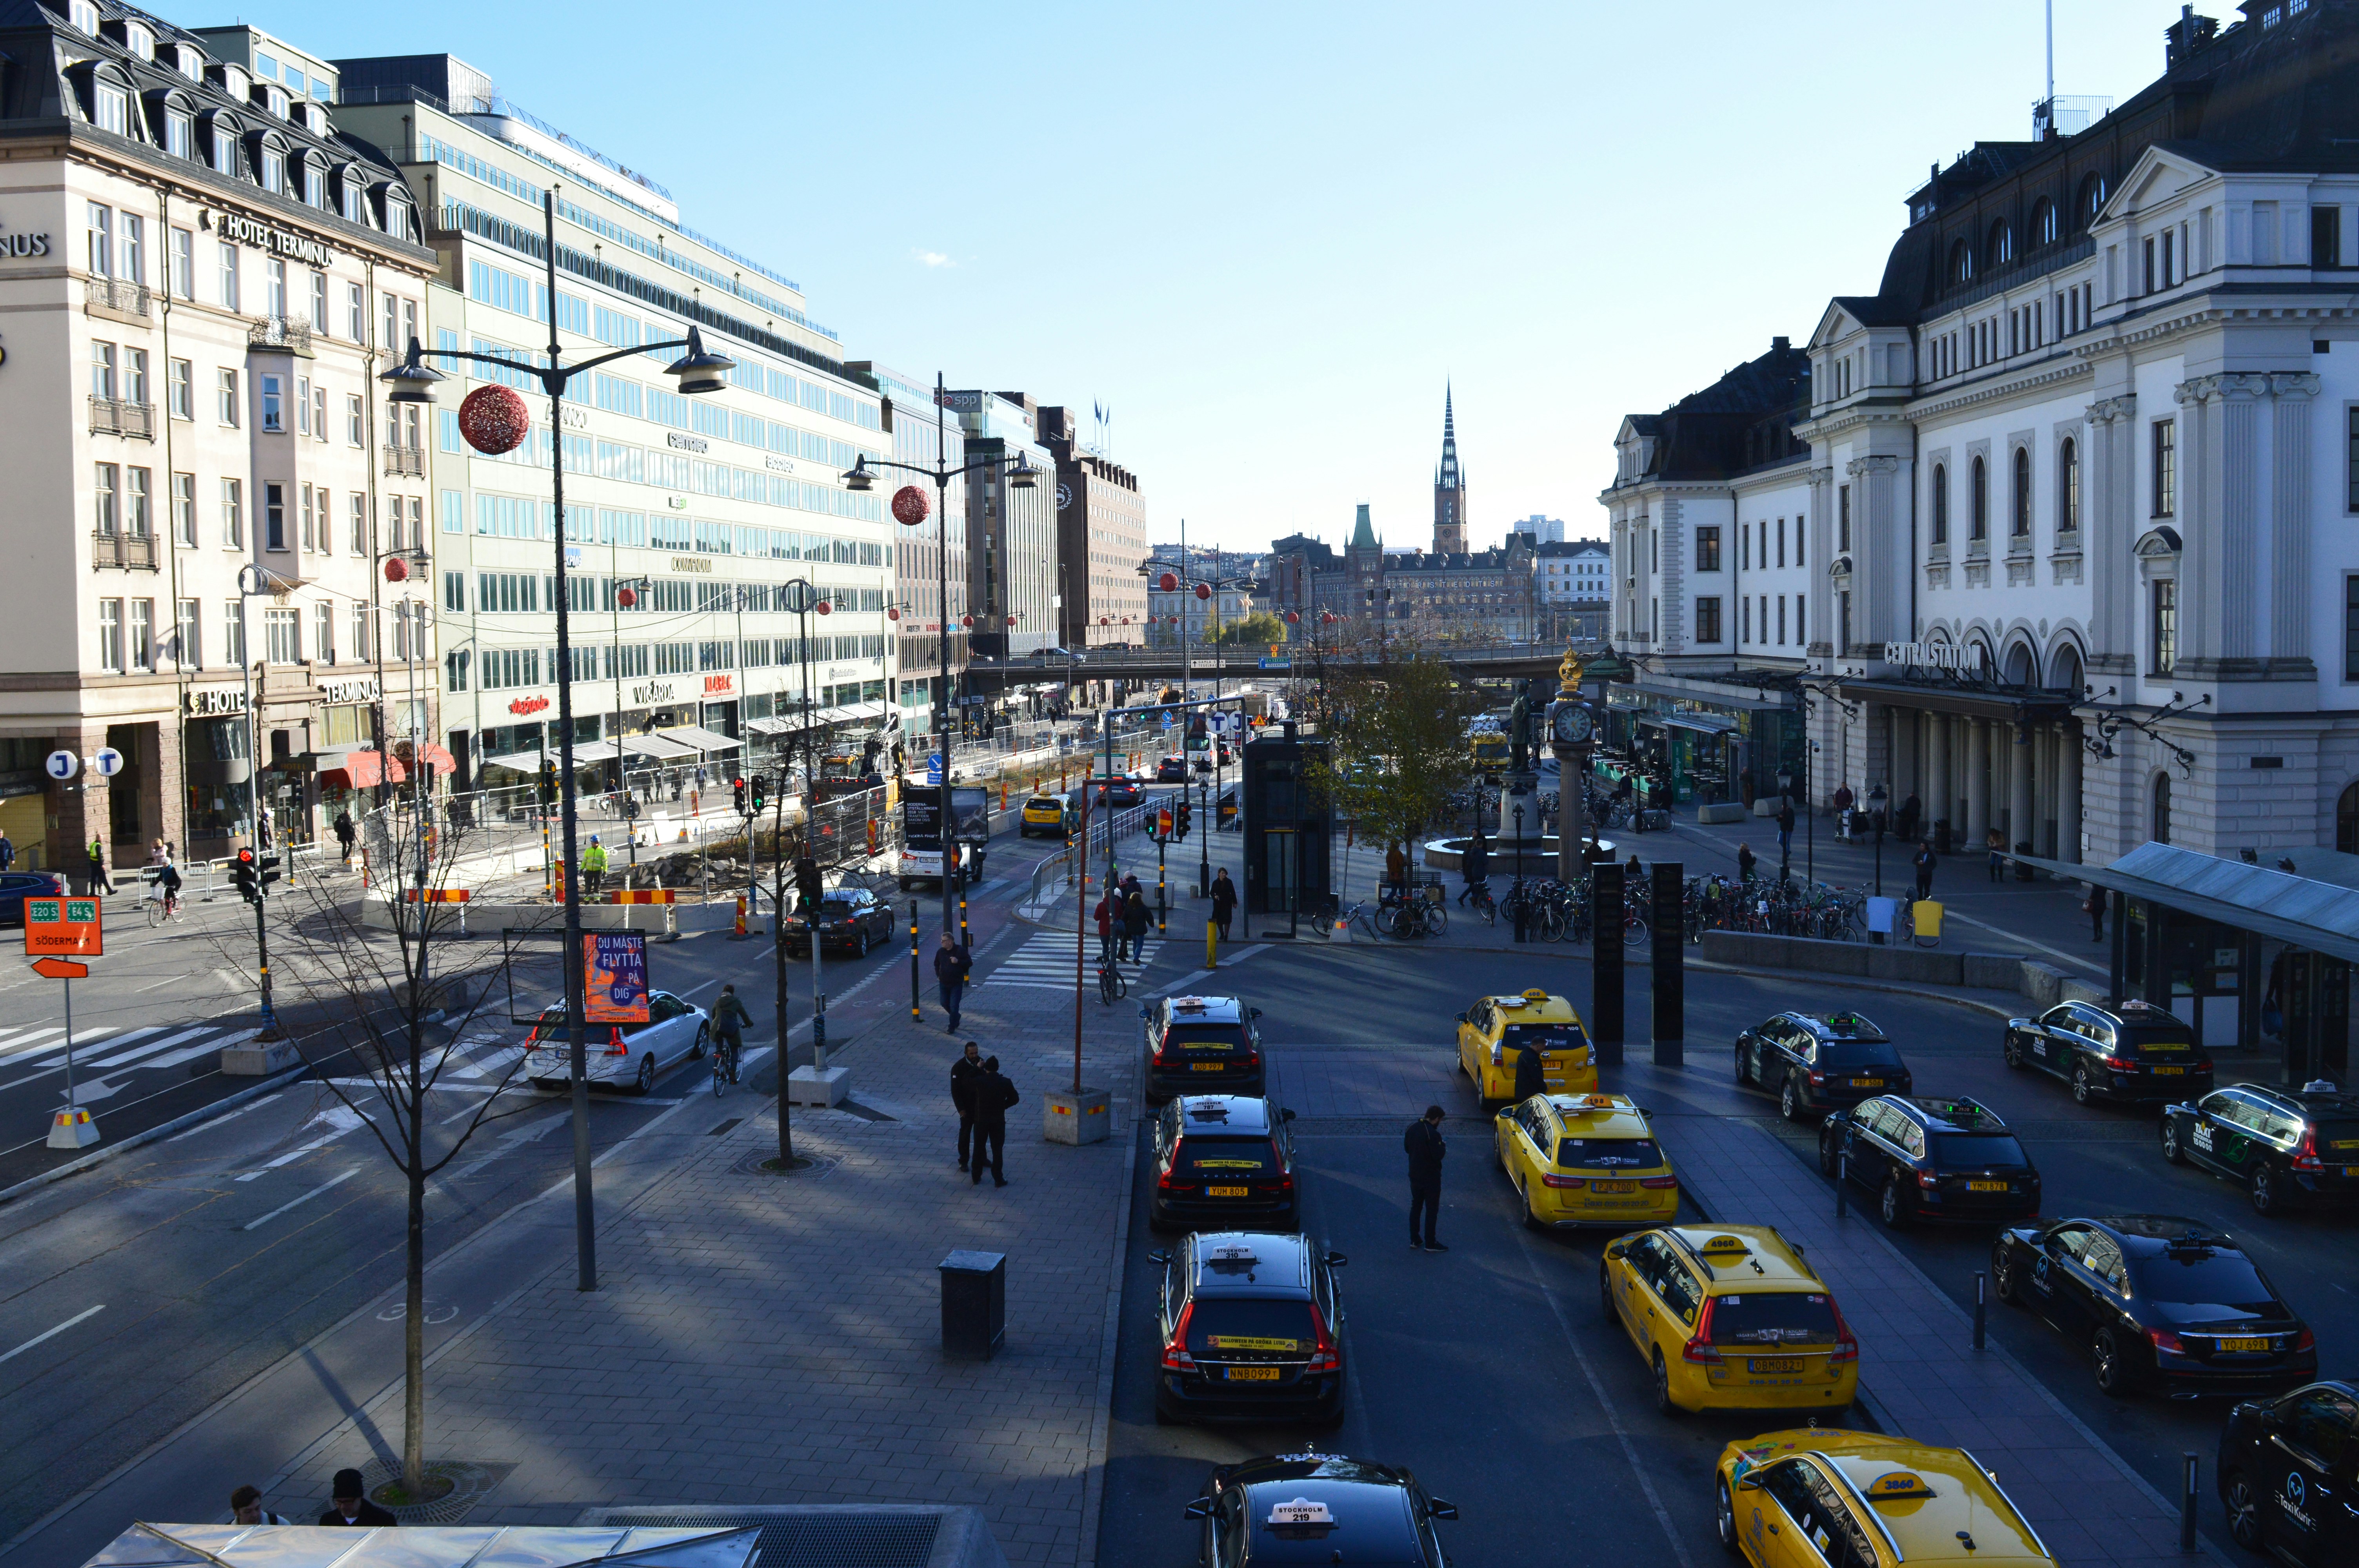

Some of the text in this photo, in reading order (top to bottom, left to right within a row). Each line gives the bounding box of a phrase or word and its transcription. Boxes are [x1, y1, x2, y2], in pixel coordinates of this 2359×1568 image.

[229, 214, 333, 267] HOTEL TERMINUS
[955, 395, 977, 407] spp
[668, 432, 708, 453] centigo
[565, 555, 582, 566] KPMG
[671, 557, 712, 572] CONVENDUM
[1884, 641, 1981, 670] CENTRALSTATION
[323, 679, 380, 702] TERMINUS
[636, 681, 675, 704] VIGÅRDA
[511, 695, 550, 716] VAPIANO
[1211, 717, 1225, 730] T
[1232, 714, 1241, 730] J
[55, 755, 68, 776] J
[99, 754, 116, 772] T
[33, 907, 56, 916] E20 S
[73, 907, 89, 916] E4 S
[599, 935, 643, 948] DU MÅSTE
[603, 953, 642, 967] FLYTTA
[629, 970, 640, 983] PÅ
[614, 988, 629, 999] DIG
[2034, 1037, 2045, 1047] TAXI
[2195, 1122, 2210, 1138] TAXI
[2246, 1340, 2265, 1349] 698
[1231, 1368, 1270, 1378] NNB099
[1885, 1479, 1914, 1490] 3860
[2280, 1493, 2311, 1526] TaxiKurir
